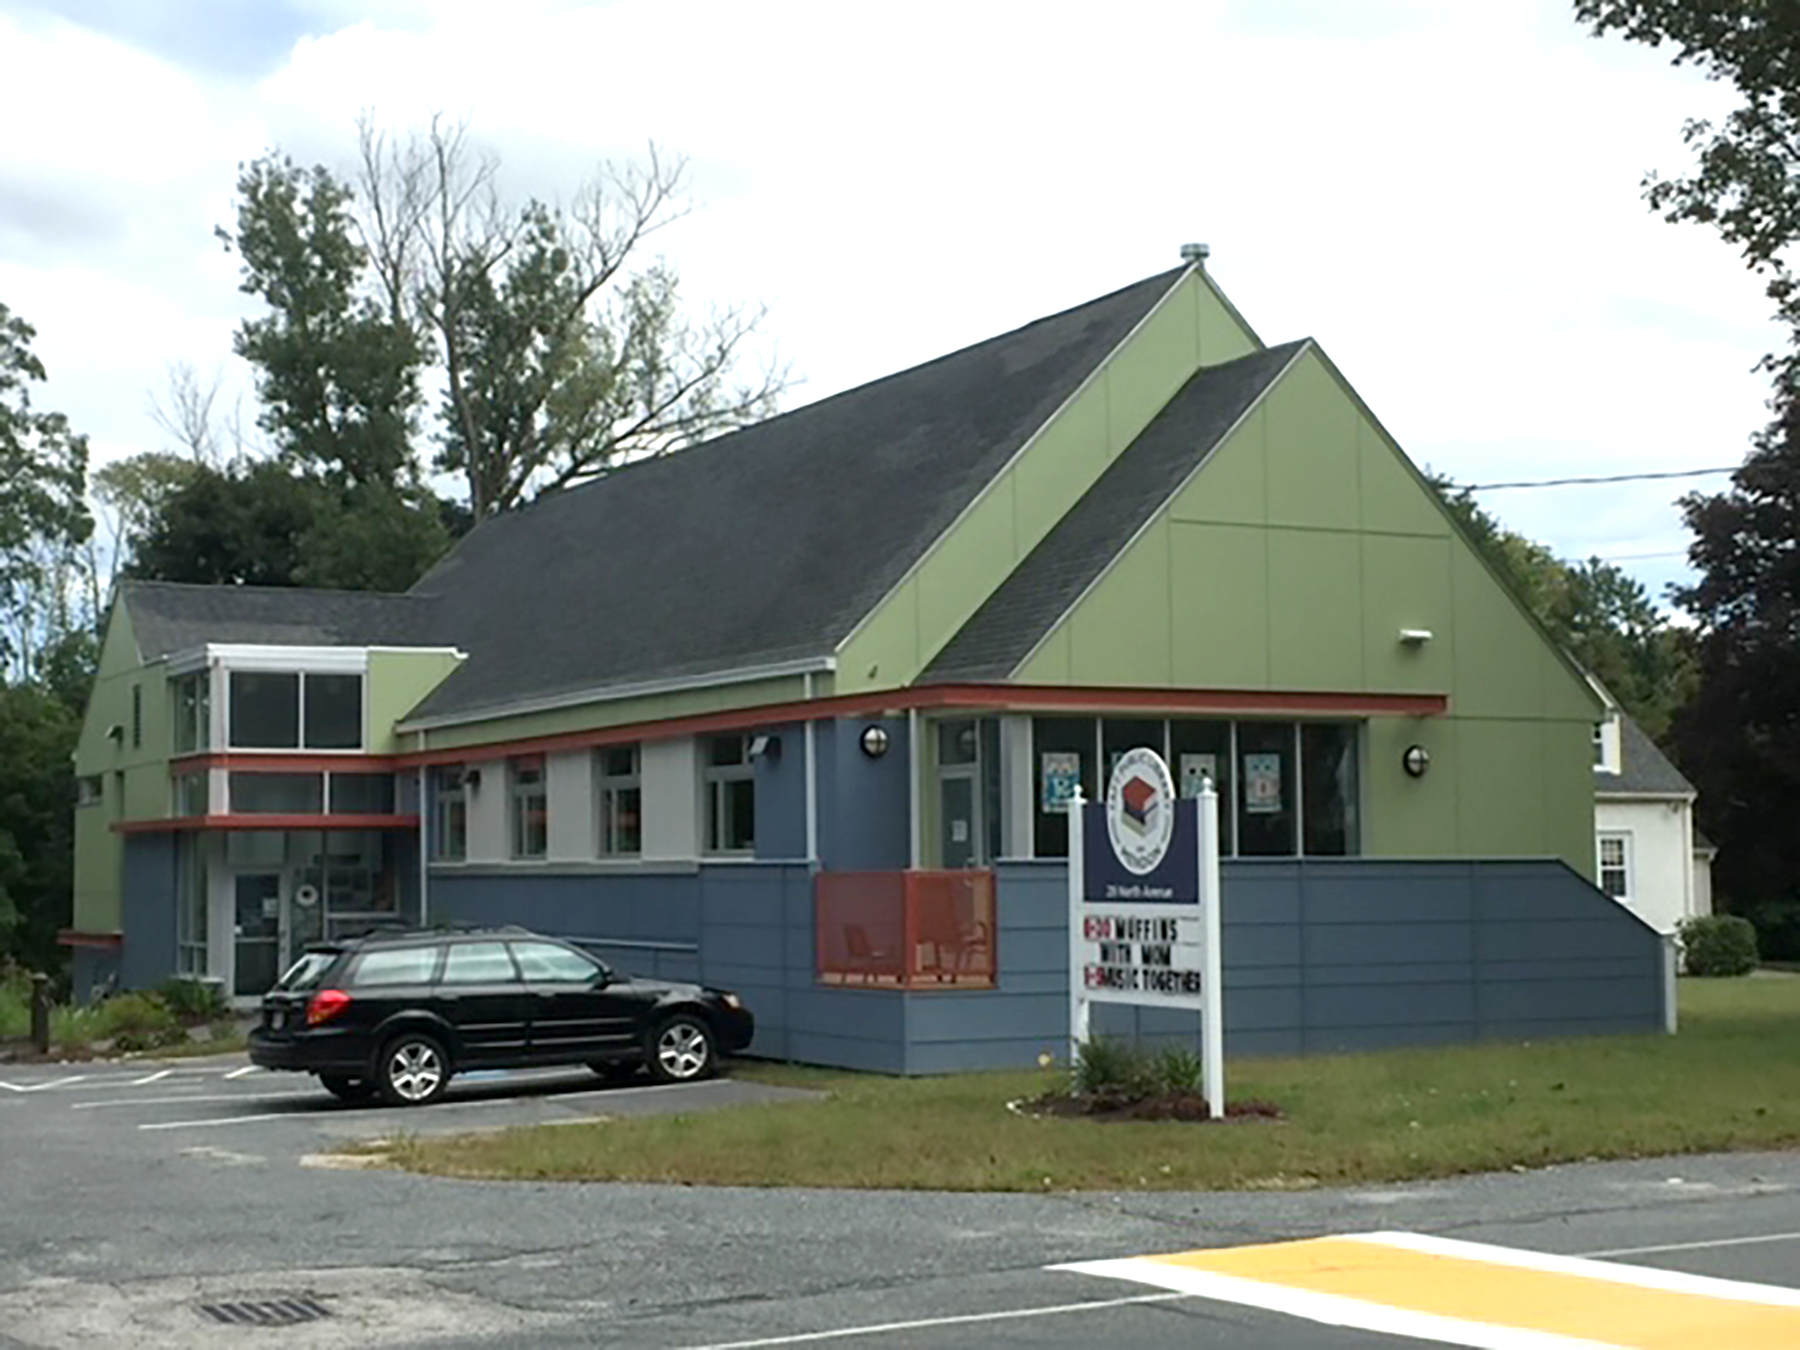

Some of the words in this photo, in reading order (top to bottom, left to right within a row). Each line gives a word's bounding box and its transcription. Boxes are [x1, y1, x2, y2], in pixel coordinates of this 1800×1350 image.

[1118, 884, 1141, 899] North
[1142, 884, 1174, 899] Avenue
[1115, 916, 1178, 941] MUFFINS
[1100, 943, 1131, 964] WITH
[1141, 943, 1171, 966] MOM
[1142, 967, 1202, 996] TOGETHER
